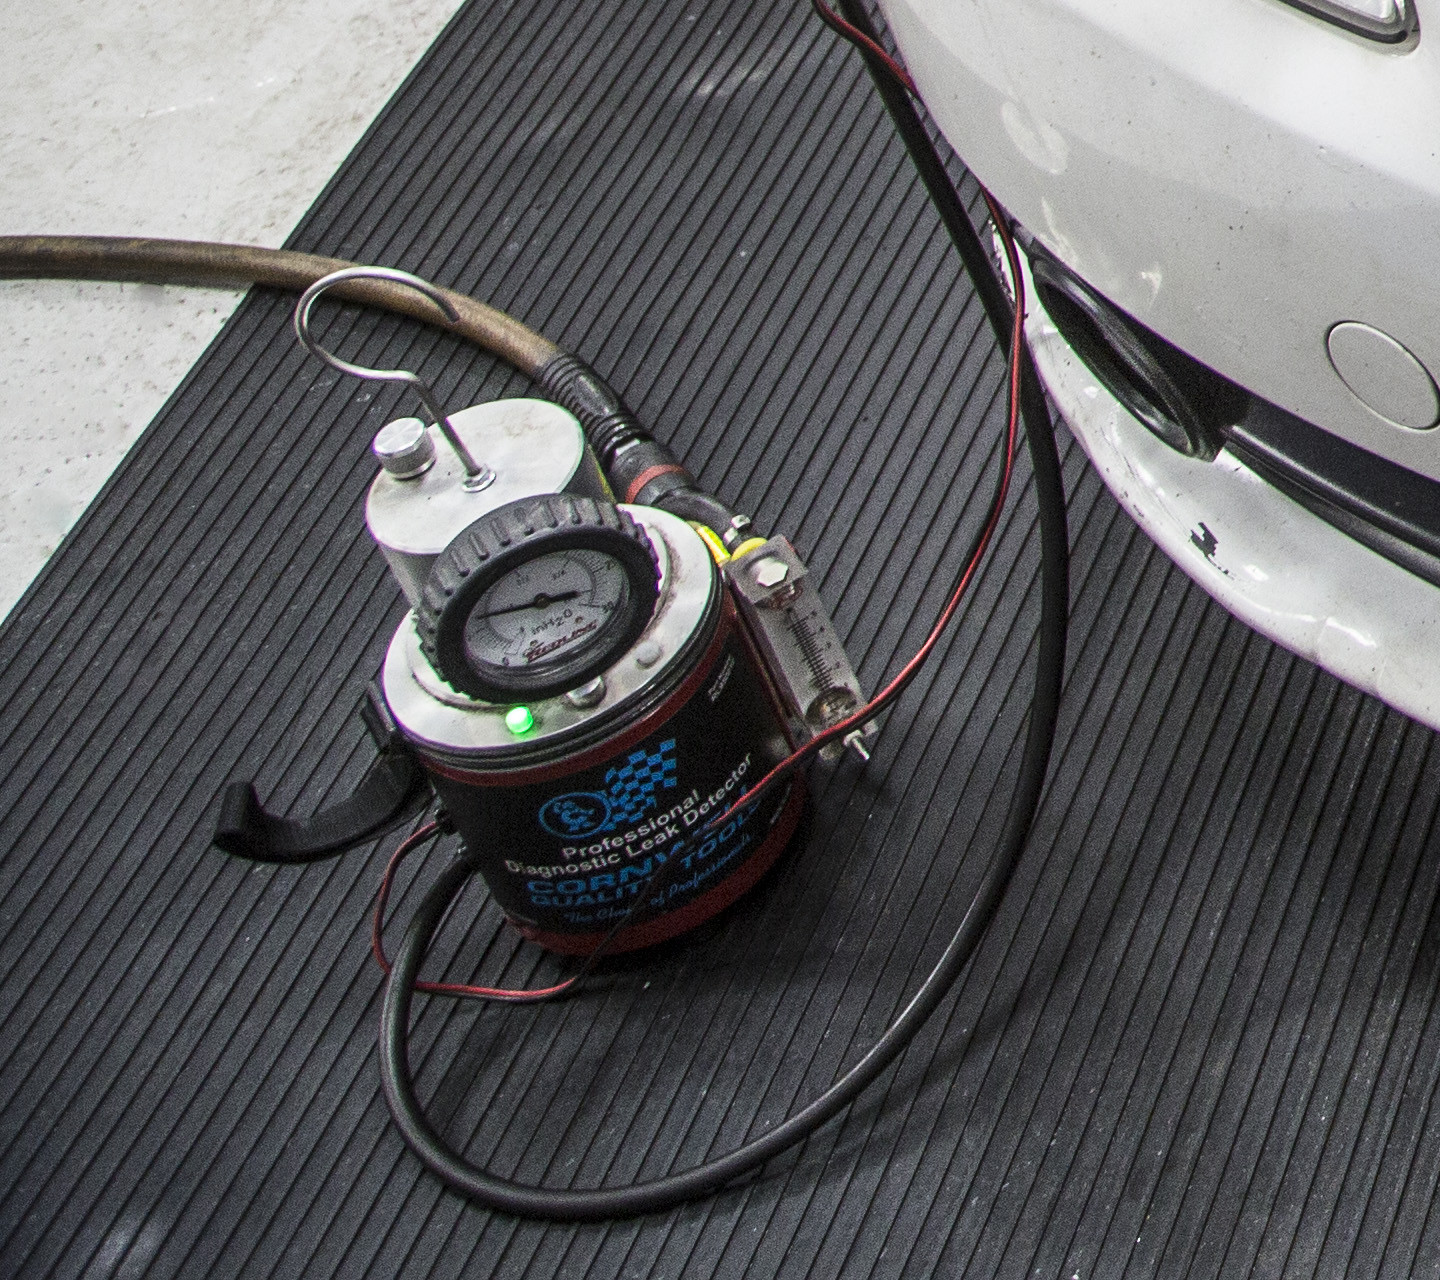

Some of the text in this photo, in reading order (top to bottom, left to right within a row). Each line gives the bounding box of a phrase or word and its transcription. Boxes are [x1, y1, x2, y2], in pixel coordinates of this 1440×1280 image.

[505, 753, 753, 878] Diagnostic Leak Detector
[561, 789, 700, 860] Professional
